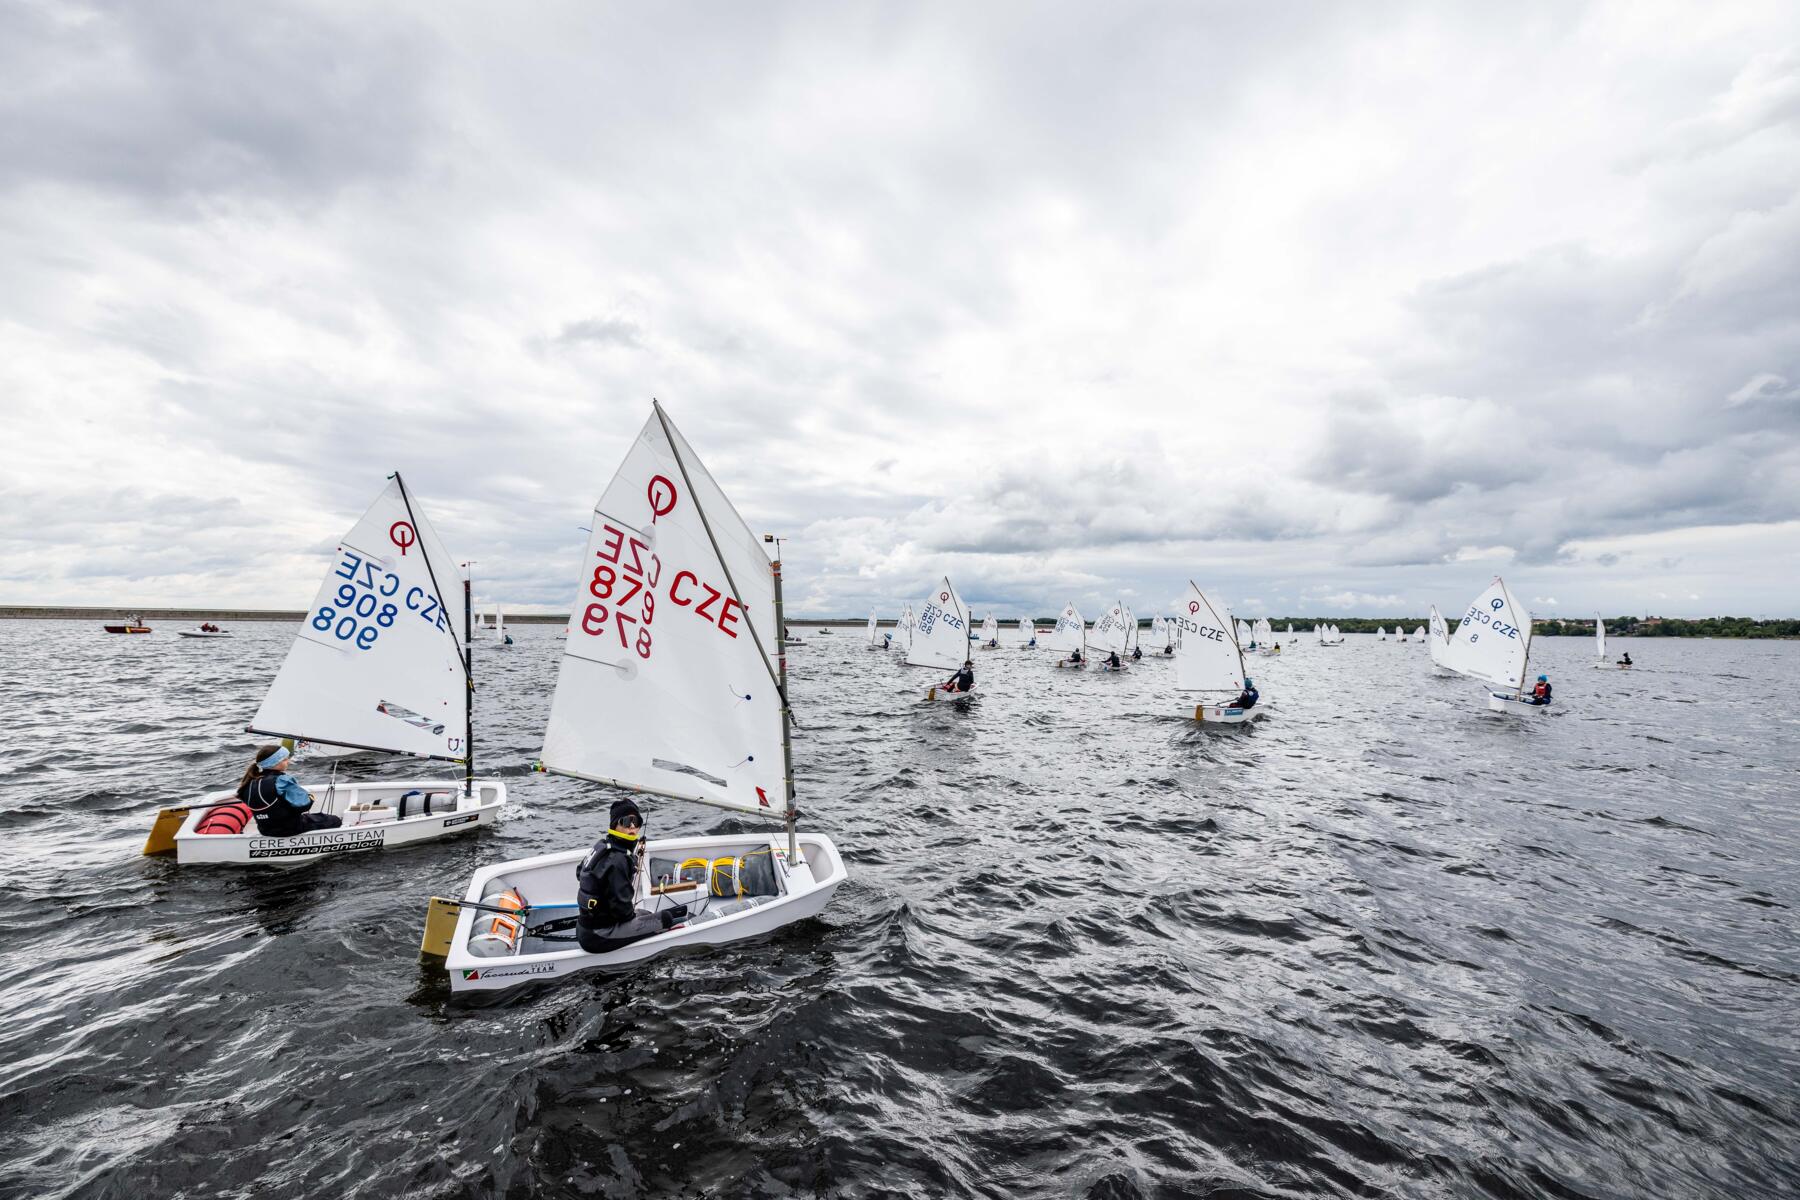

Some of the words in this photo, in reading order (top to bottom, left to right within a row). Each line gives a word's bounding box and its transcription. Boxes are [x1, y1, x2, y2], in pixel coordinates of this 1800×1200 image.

[334, 584, 398, 627] 908
[590, 565, 655, 625] 879
[669, 570, 749, 639] CZE
[406, 587, 446, 634] CZE
[1462, 616, 1471, 626] 8
[943, 613, 963, 630] CZE
[1492, 620, 1519, 639] CZE
[1199, 626, 1225, 642] CZE
[249, 838, 286, 850] CERE
[289, 834, 344, 847] SAILING
[348, 829, 385, 842] TEAM
